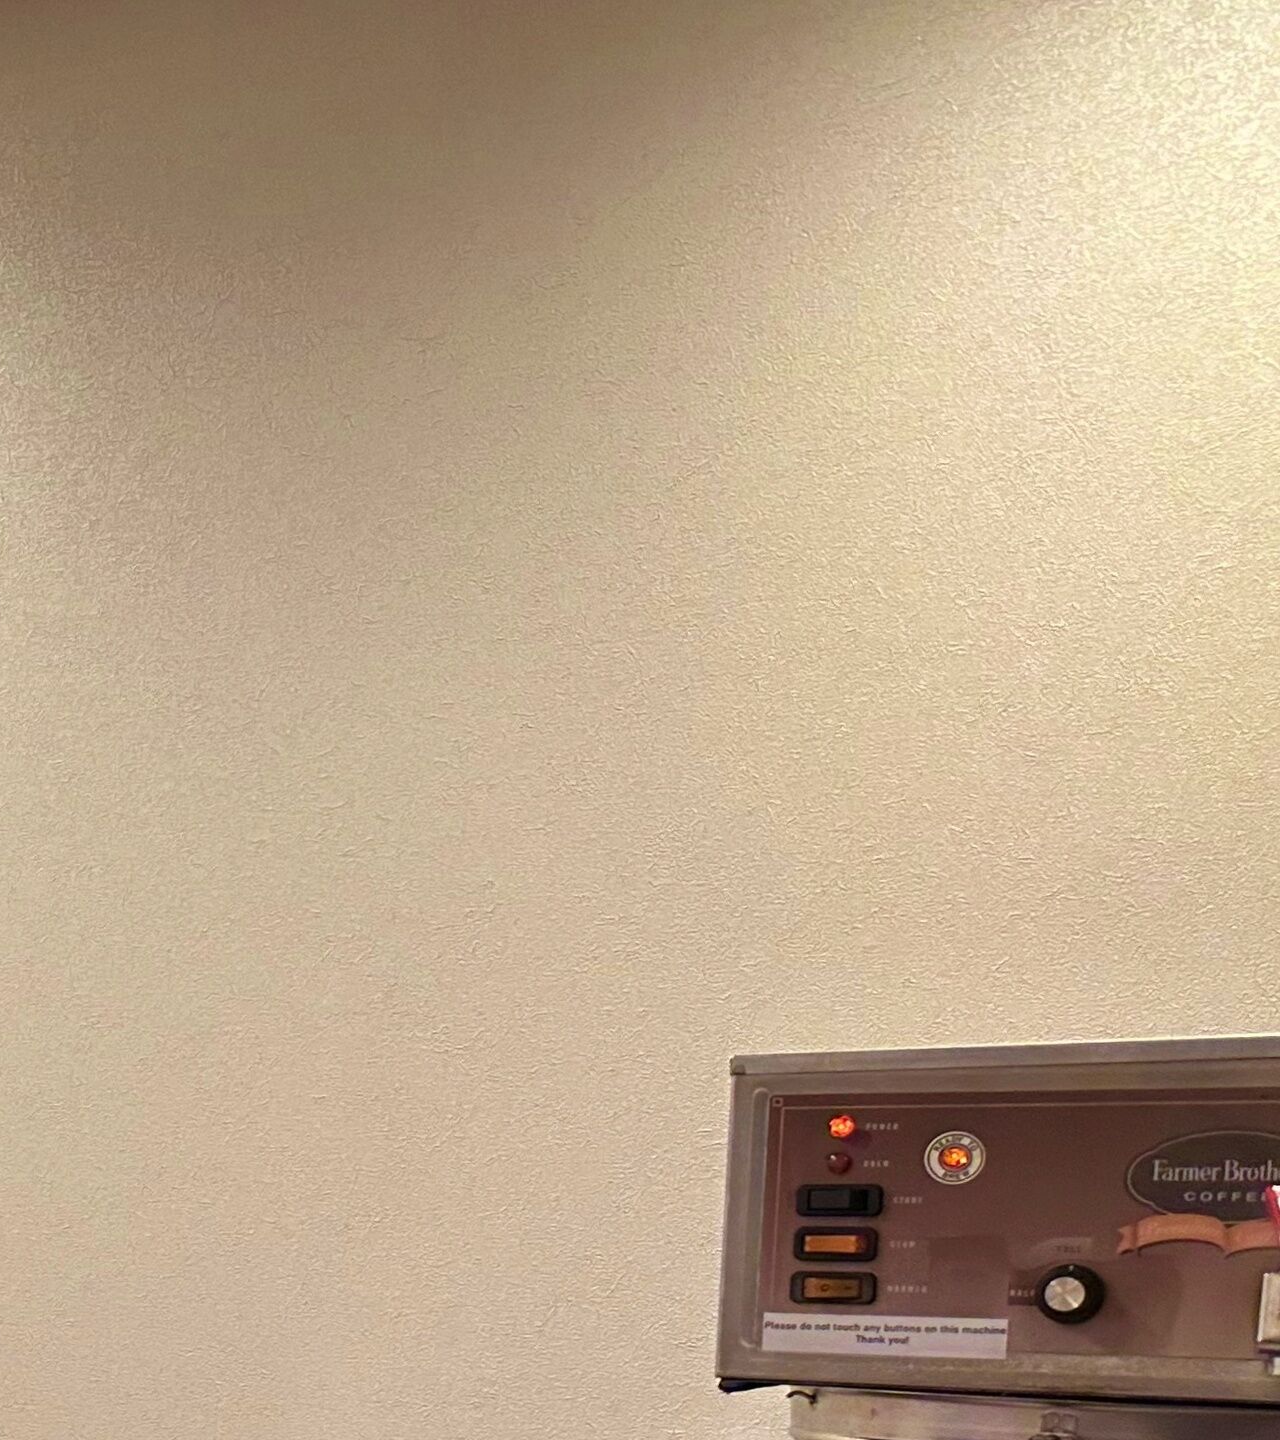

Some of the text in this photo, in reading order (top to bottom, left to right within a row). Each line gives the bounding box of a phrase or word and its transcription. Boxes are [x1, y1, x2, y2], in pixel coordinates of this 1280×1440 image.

[1152, 1159, 1222, 1182] Farmer
[764, 1321, 798, 1331] Please
[799, 1322, 813, 1331] do
[815, 1322, 832, 1331] not
[833, 1322, 860, 1332] touch
[863, 1325, 881, 1334] any
[883, 1323, 922, 1333] buttons
[940, 1325, 959, 1333] this
[961, 1326, 1006, 1335] machine
[856, 1334, 910, 1346] Thank you!
